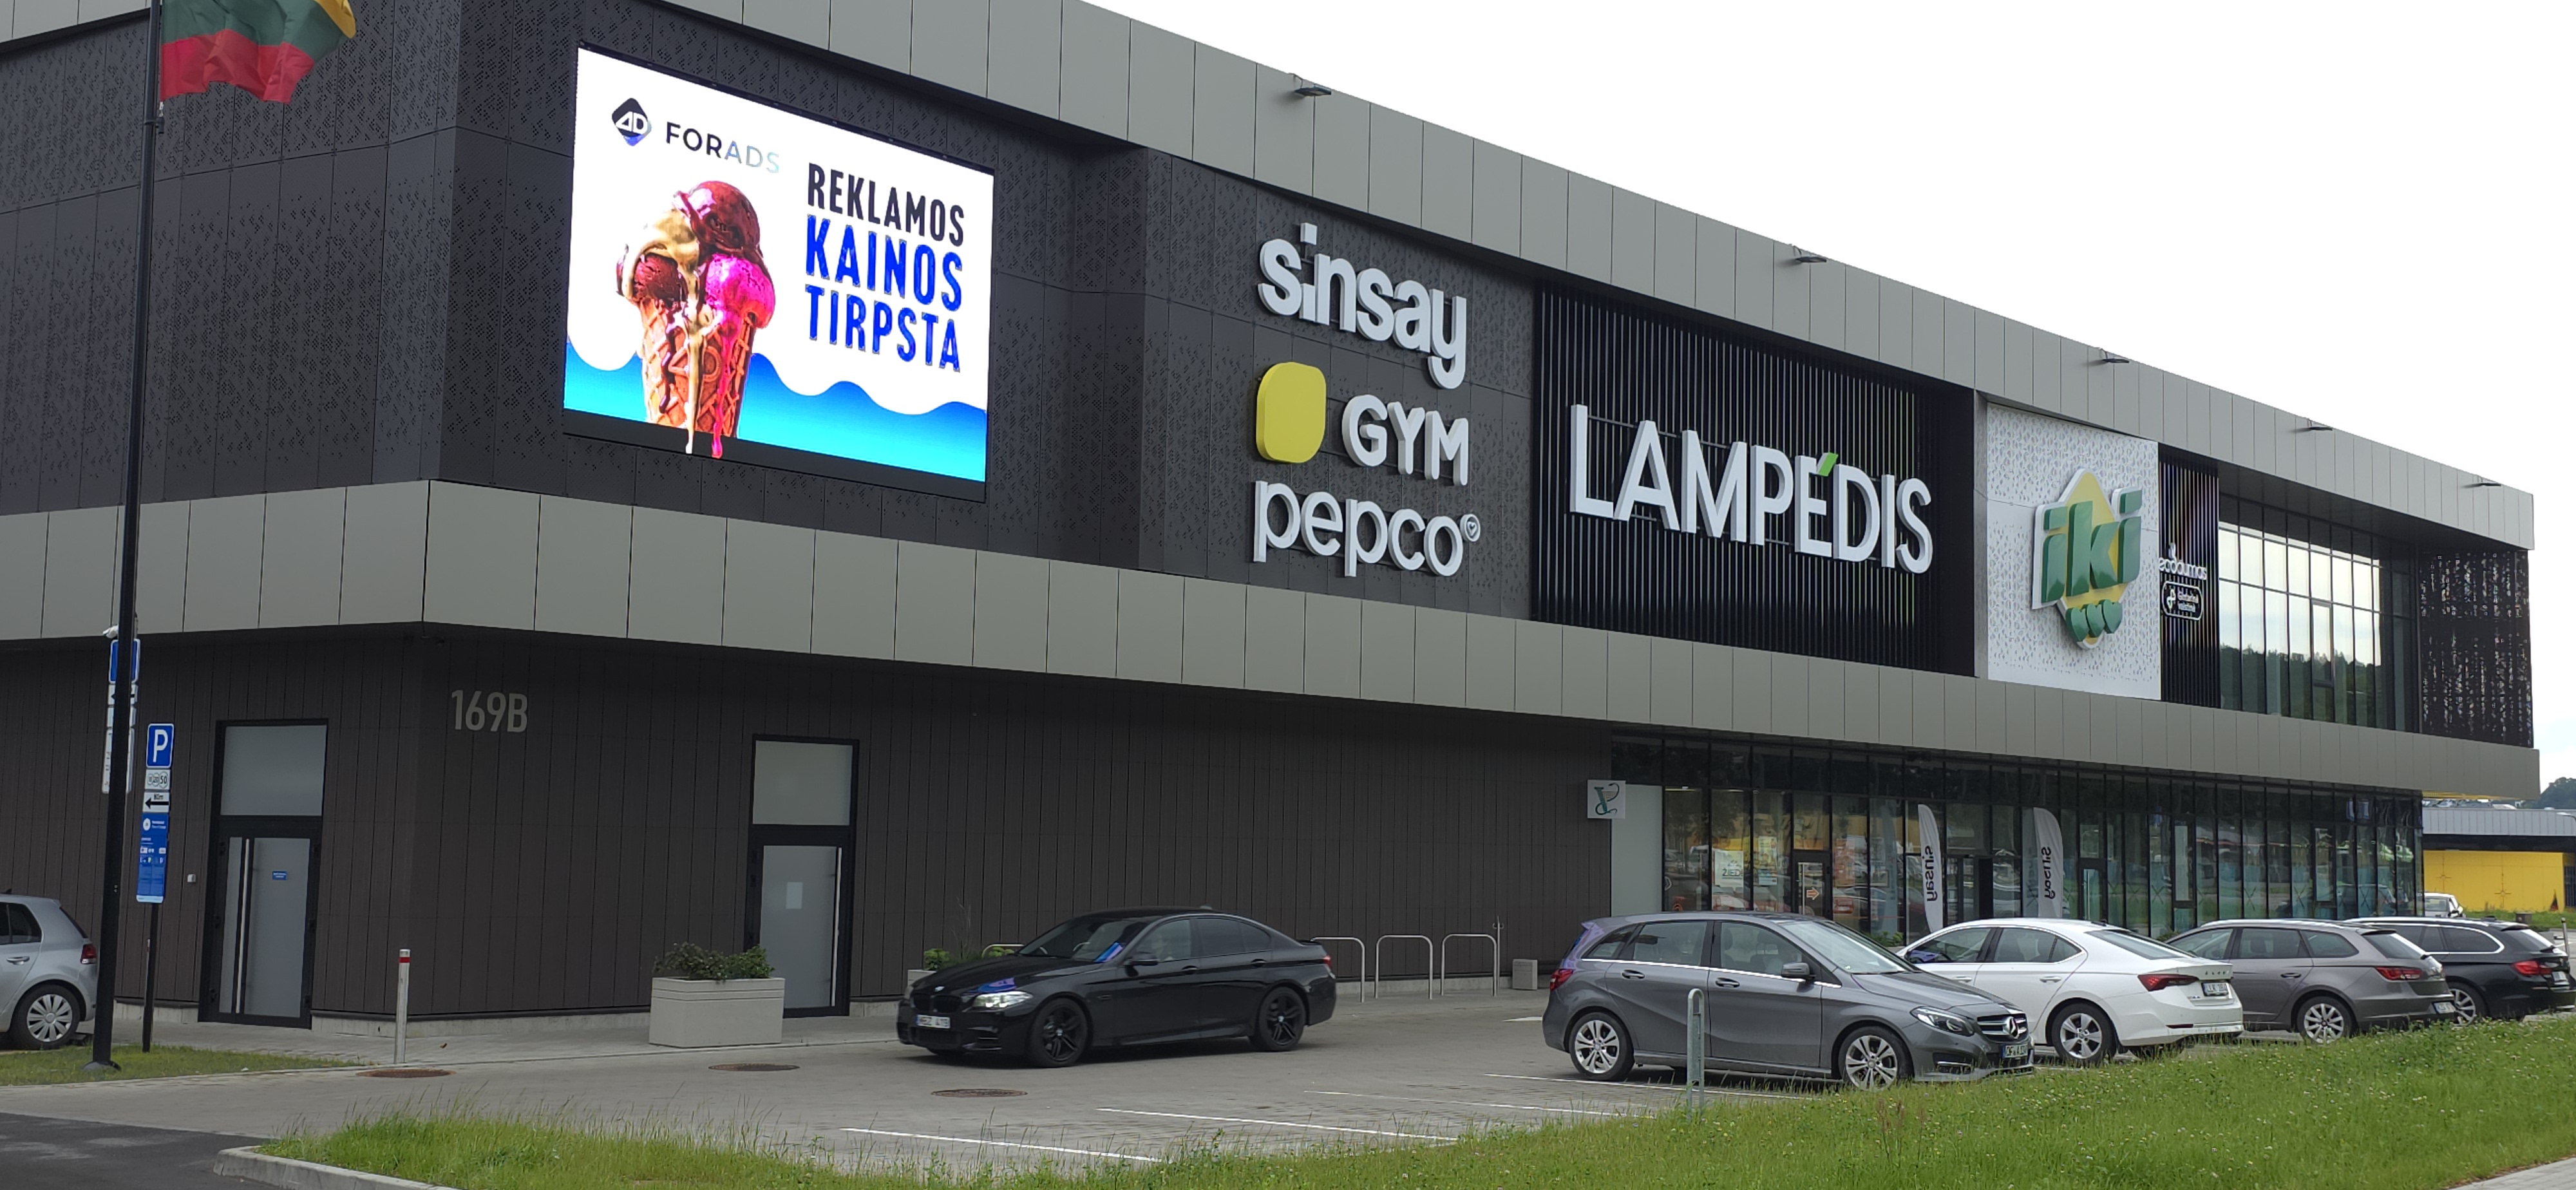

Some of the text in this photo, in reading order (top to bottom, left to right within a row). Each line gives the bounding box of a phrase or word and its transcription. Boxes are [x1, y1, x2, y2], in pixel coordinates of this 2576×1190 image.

[665, 121, 779, 173] FORADS
[807, 162, 965, 247] REKLAMOS
[805, 214, 963, 312] KAINOS
[1258, 222, 1467, 390] sinsay
[804, 285, 961, 373] TIRPSTA
[1341, 393, 1469, 486] GYM
[1253, 480, 1464, 578] pepco
[2041, 489, 2143, 603] iki
[152, 728, 169, 763] P
[451, 689, 528, 733] 169B
[159, 775, 167, 784] 50
